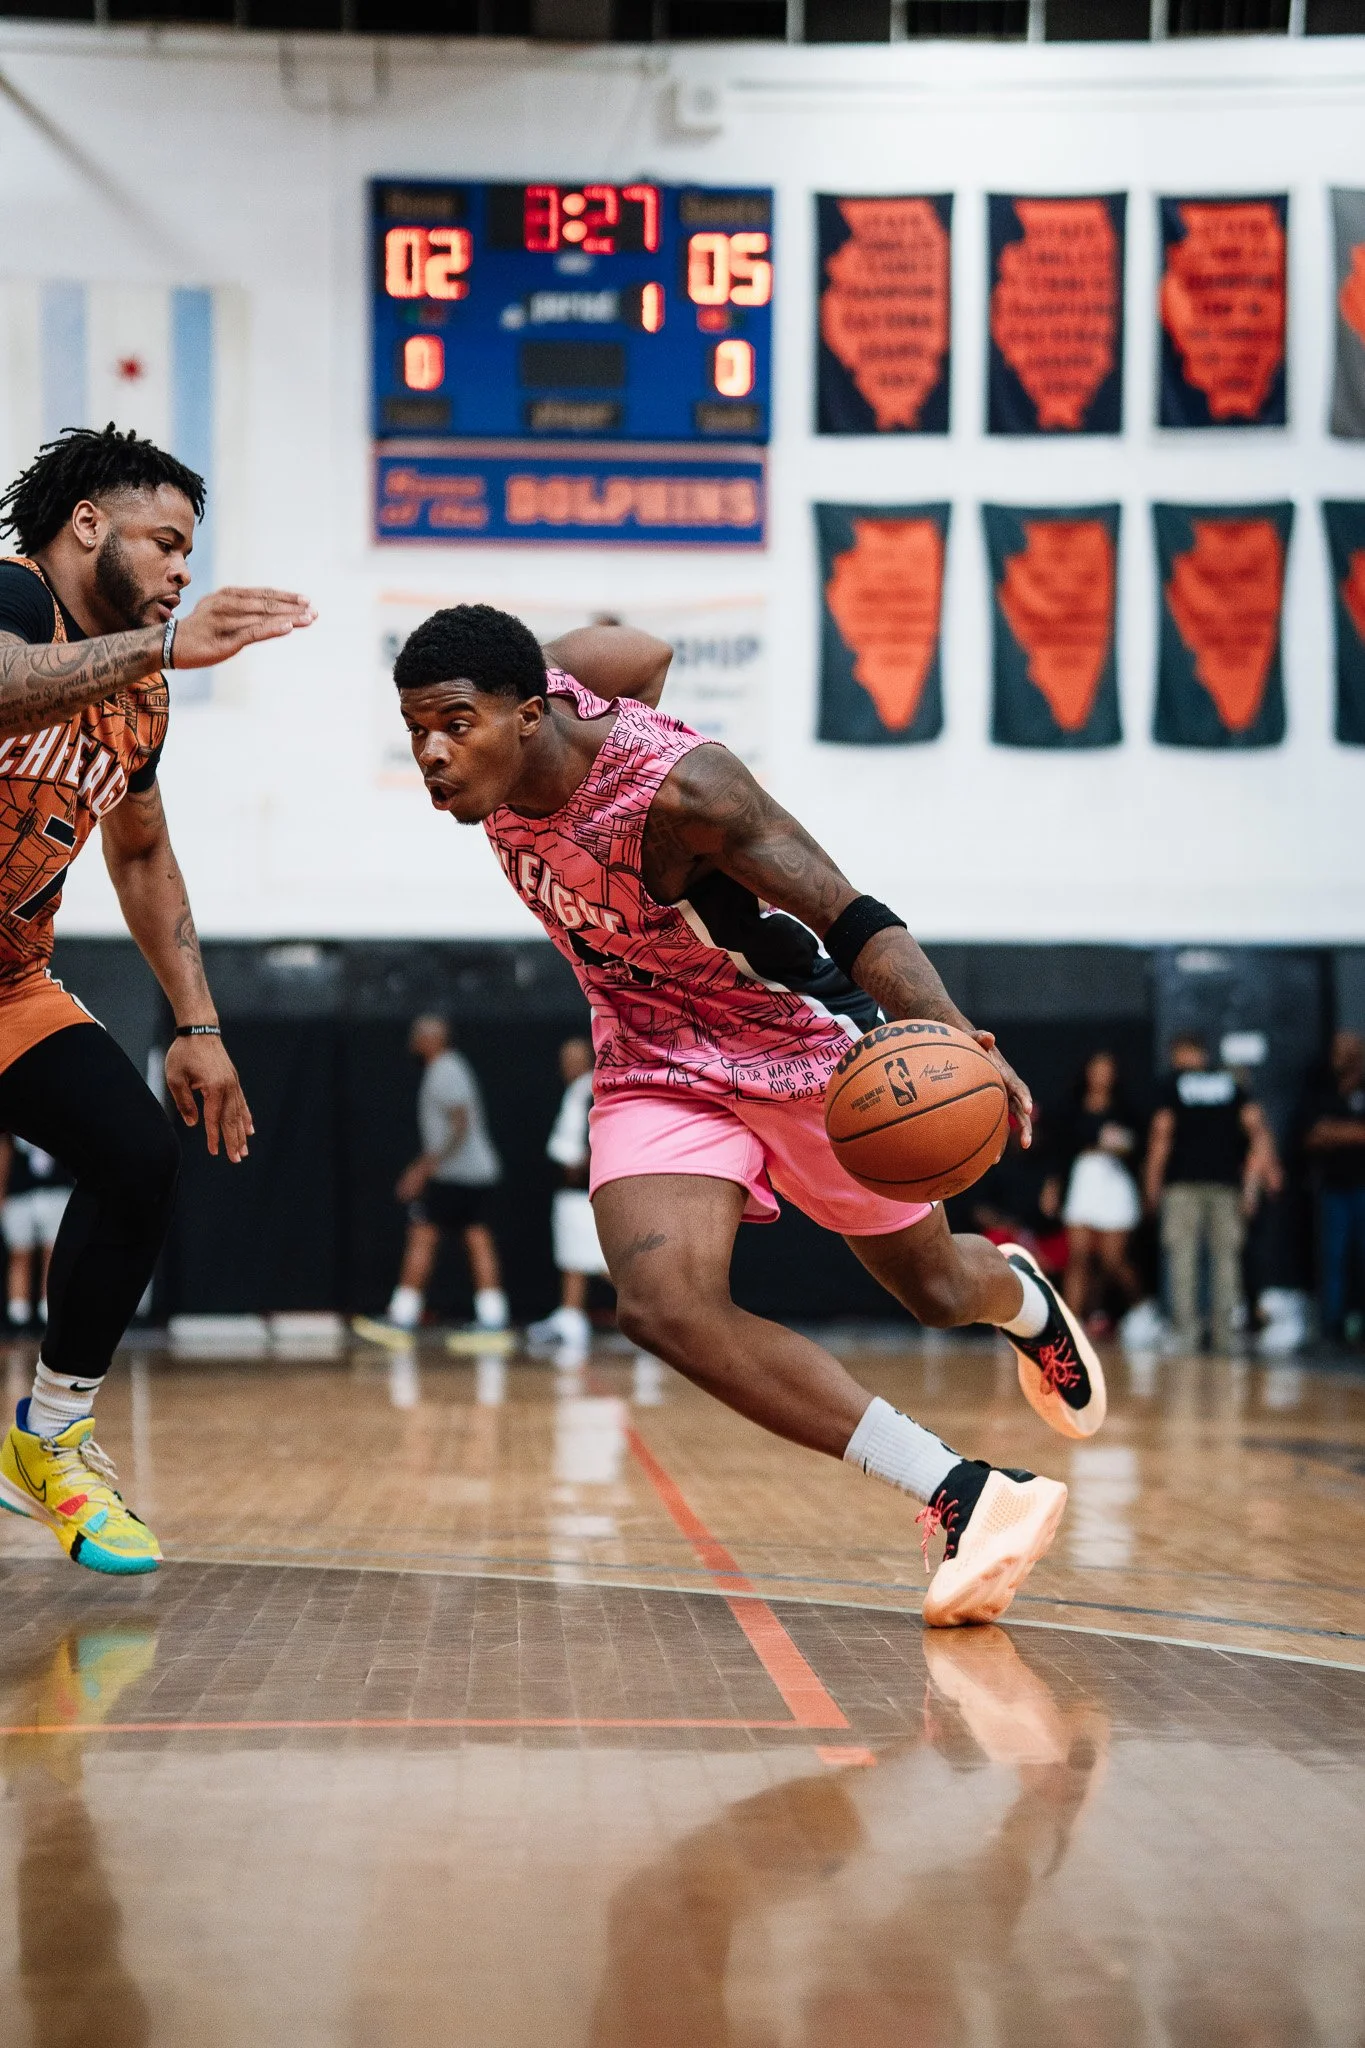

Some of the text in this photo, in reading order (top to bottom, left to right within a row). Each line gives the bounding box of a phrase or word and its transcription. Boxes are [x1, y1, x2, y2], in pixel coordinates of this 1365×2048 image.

[384, 225, 473, 301] 02
[687, 231, 774, 307] 05
[641, 281, 665, 334] 1
[404, 333, 446, 392] 0
[714, 338, 756, 398] 0
[11, 814, 78, 924] 7
[191, 1026, 205, 1034] Just
[624, 1073, 654, 1085] SOUTH
[747, 1070, 766, 1082] DR.
[766, 1057, 815, 1080] MARTIN
[768, 1077, 797, 1095] KING
[801, 1071, 822, 1086] JR.
[788, 1087, 814, 1100] 400
